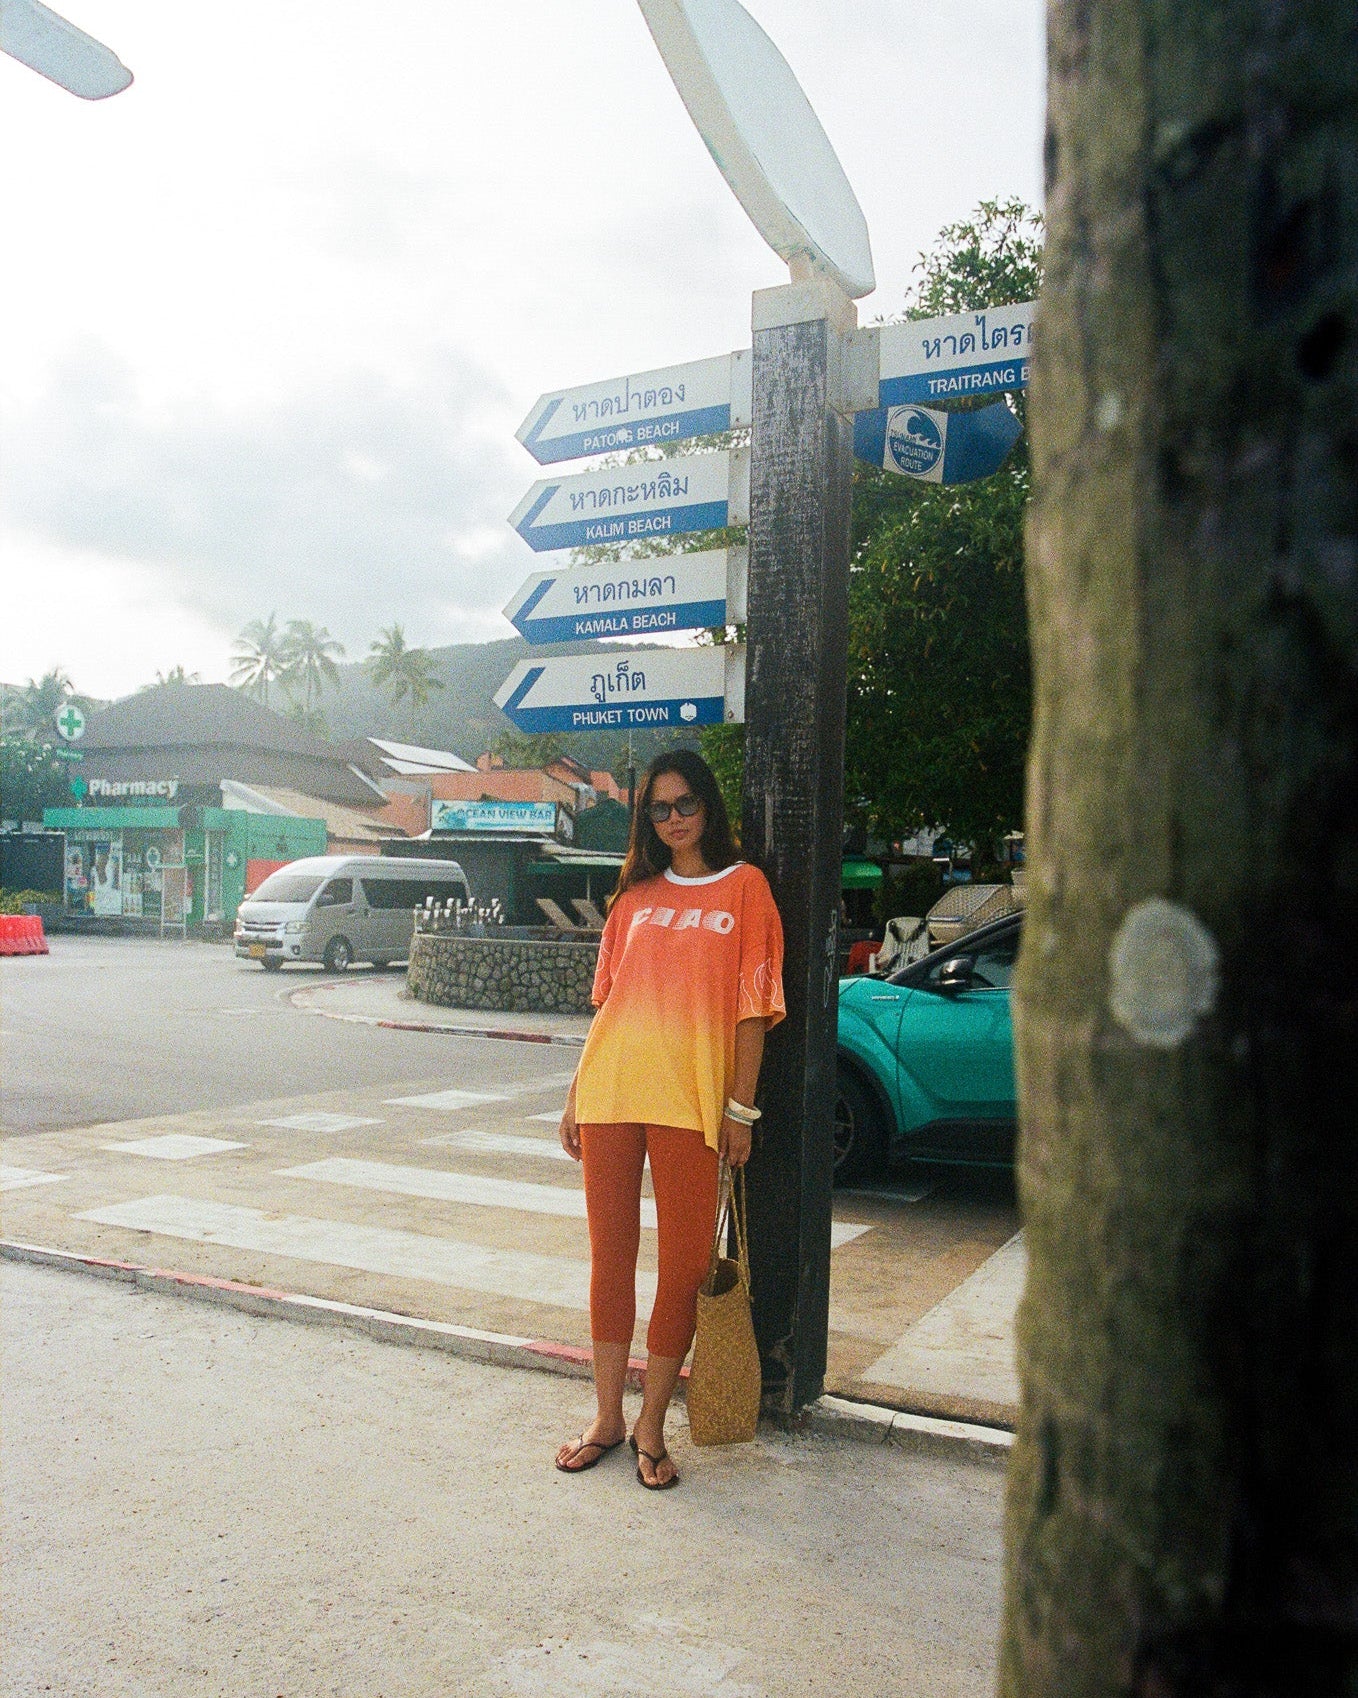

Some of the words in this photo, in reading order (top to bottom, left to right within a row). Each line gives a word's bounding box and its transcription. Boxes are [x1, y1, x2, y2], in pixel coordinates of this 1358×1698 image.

[928, 368, 1015, 395] TRAITRANG
[572, 377, 686, 422] หาดป่าตอง
[637, 421, 680, 441] BEACH
[893, 441, 934, 461] EVACUATION
[900, 456, 923, 471] ROUTE
[569, 471, 689, 511] หาดกะหลิม
[586, 521, 624, 539] KALIM
[628, 515, 671, 534] BEACH
[573, 575, 676, 604] หาดกมลา
[575, 616, 628, 635] KAMALA
[632, 612, 676, 630] BEACH
[590, 660, 646, 702] ภูเก็ต
[573, 709, 623, 725] PHUKET
[629, 707, 669, 722] TOWN
[89, 779, 178, 798] Pharmacy
[457, 808, 496, 819] OCEAN
[499, 808, 527, 819] VIEW
[529, 810, 552, 820] BAR
